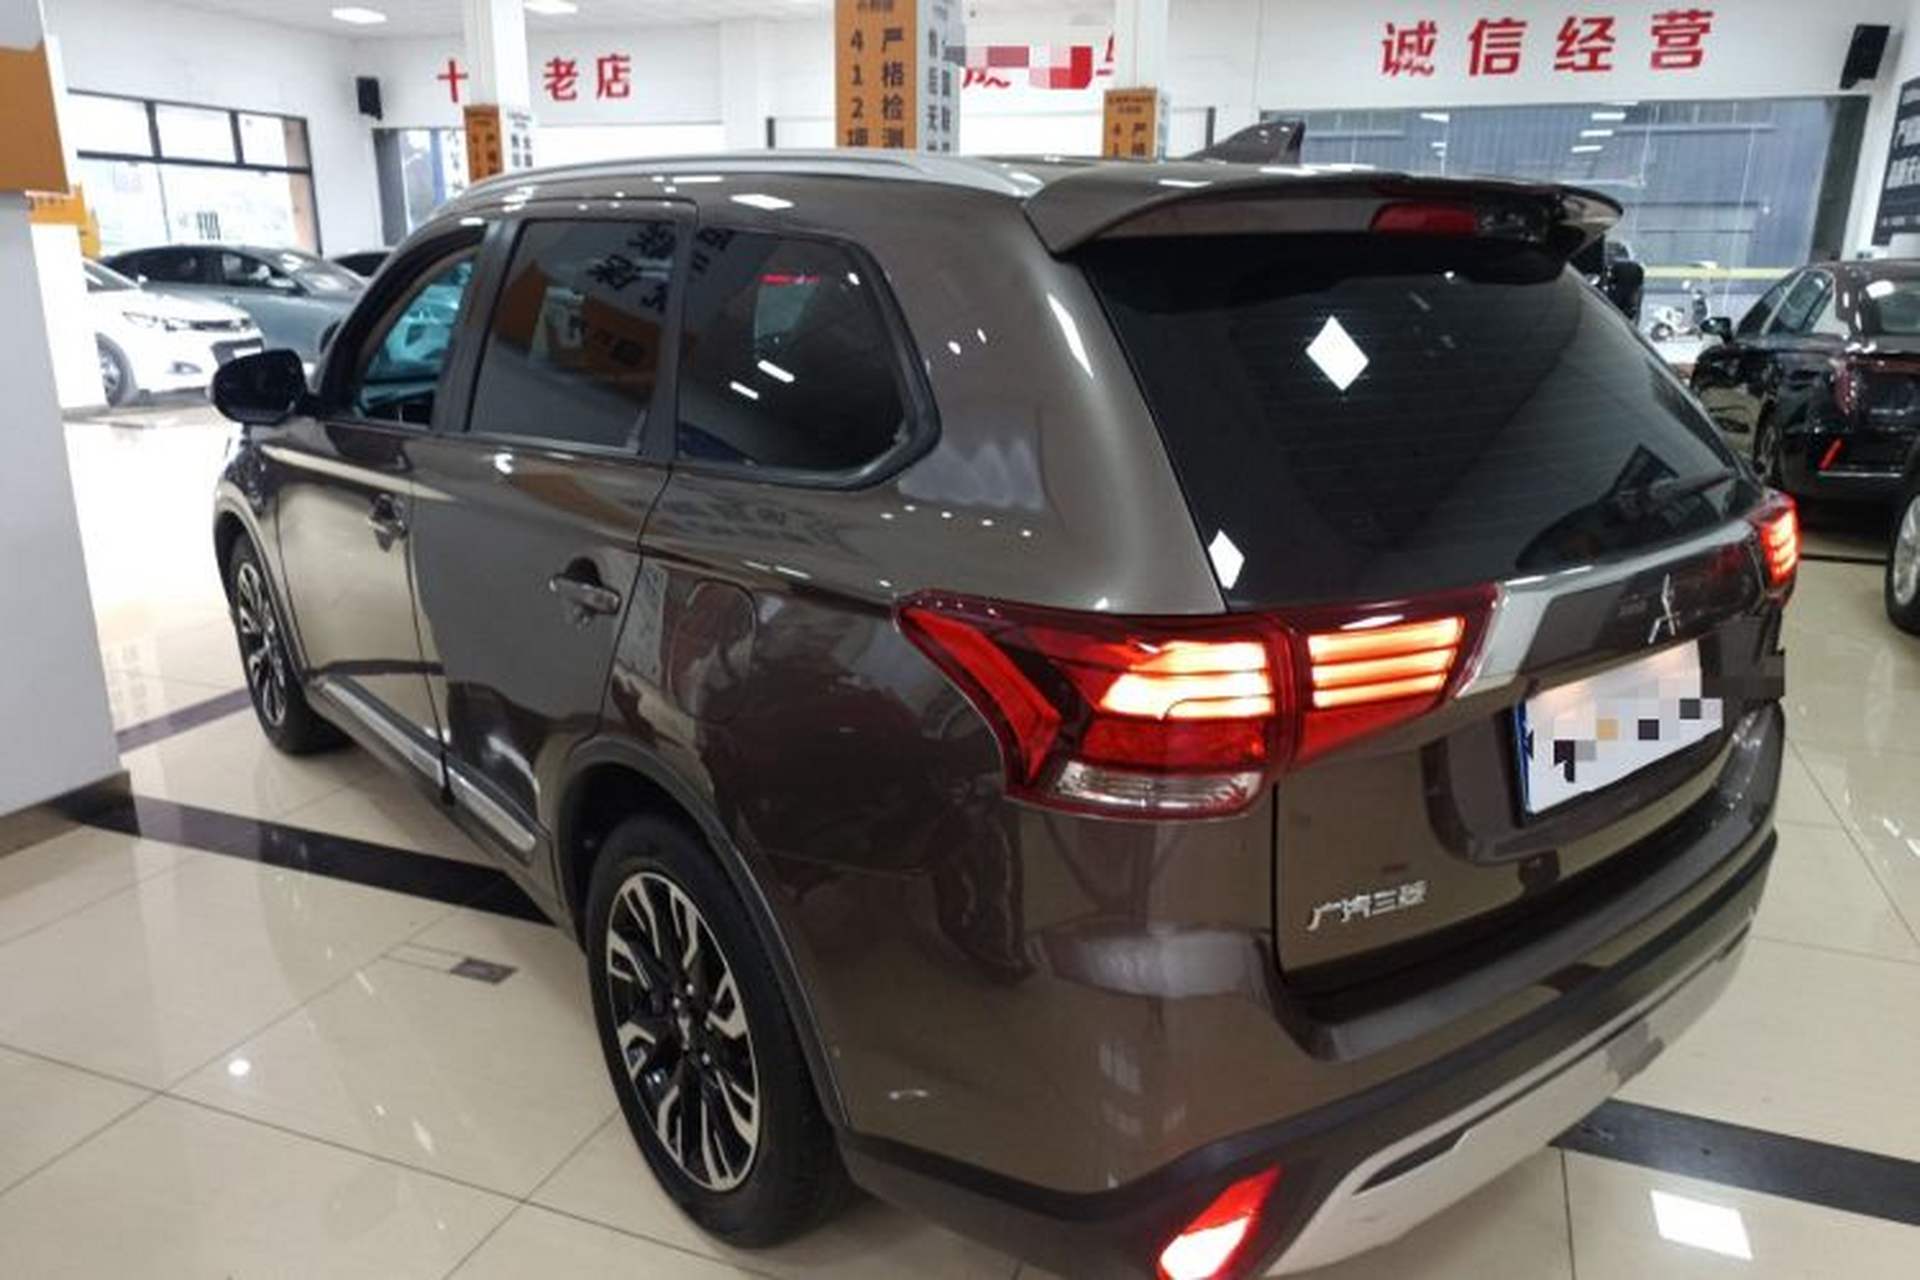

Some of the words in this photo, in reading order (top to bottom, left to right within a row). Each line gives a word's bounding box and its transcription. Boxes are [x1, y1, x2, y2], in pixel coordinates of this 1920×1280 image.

[881, 27, 905, 149] 严格检测
[1382, 10, 1713, 77] 诚信经营
